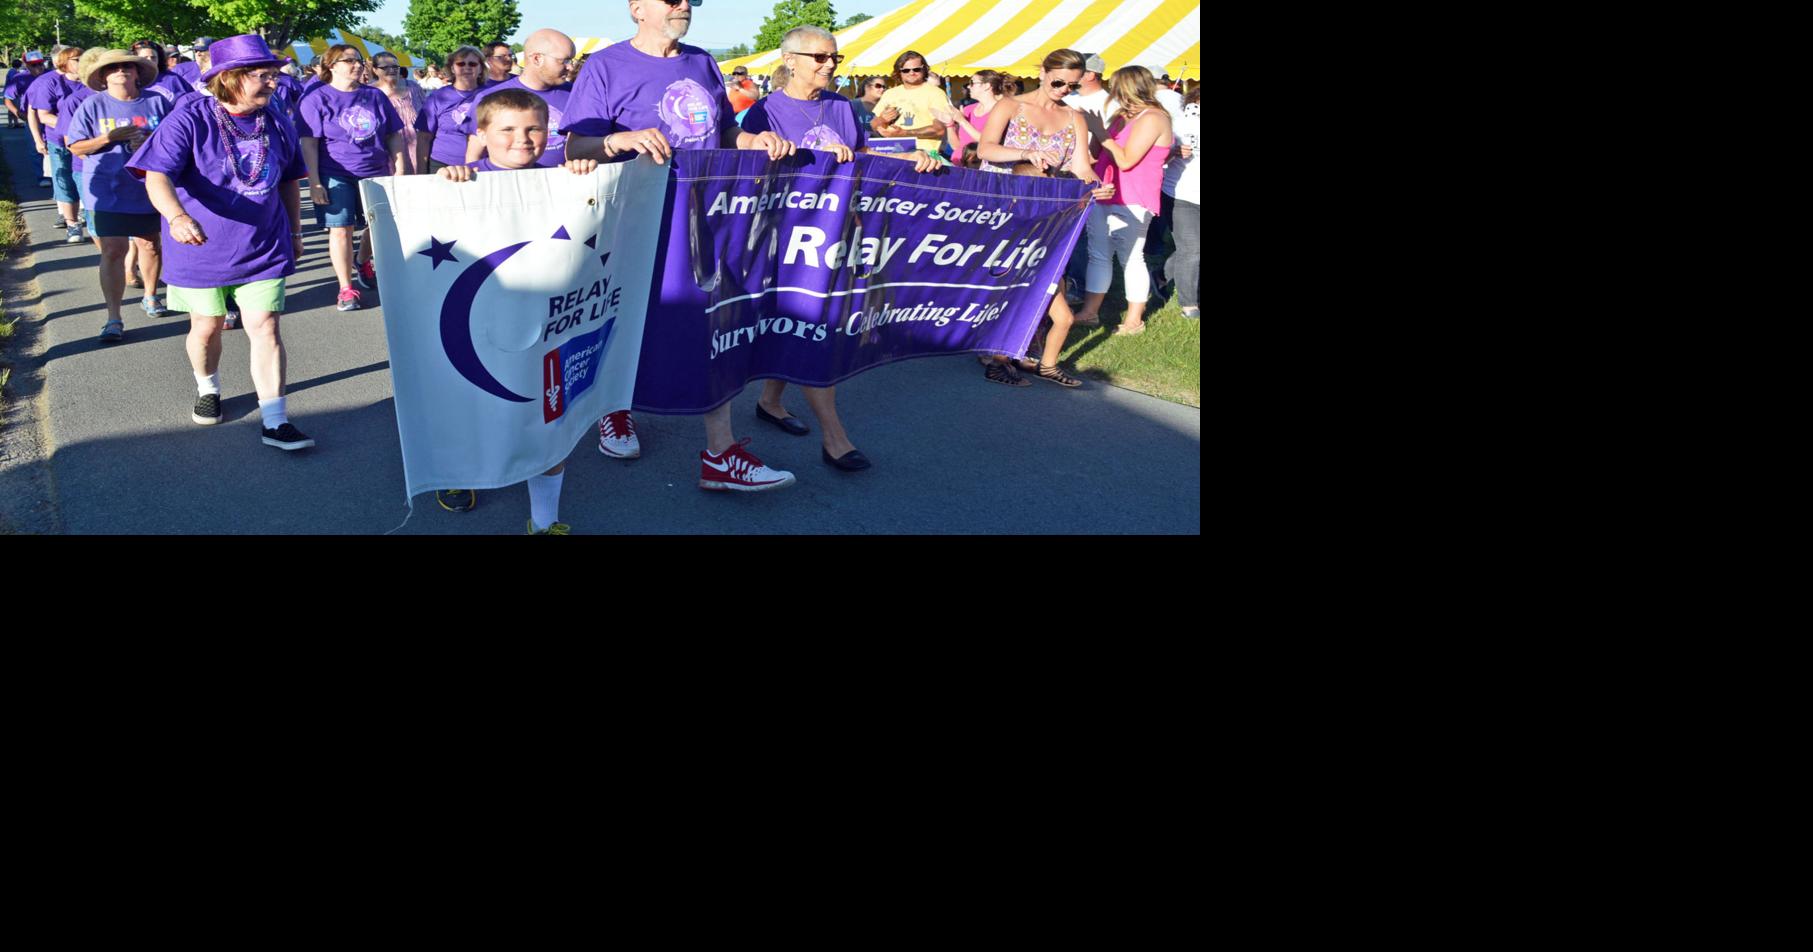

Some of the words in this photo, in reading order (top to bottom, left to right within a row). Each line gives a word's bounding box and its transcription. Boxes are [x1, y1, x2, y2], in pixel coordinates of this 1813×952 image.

[706, 191, 839, 217] American
[928, 196, 1013, 230] Society
[783, 226, 906, 274] Relay
[908, 233, 985, 267] For
[982, 237, 1047, 270] Life
[549, 275, 612, 318] RELAY
[543, 308, 584, 342] FOR
